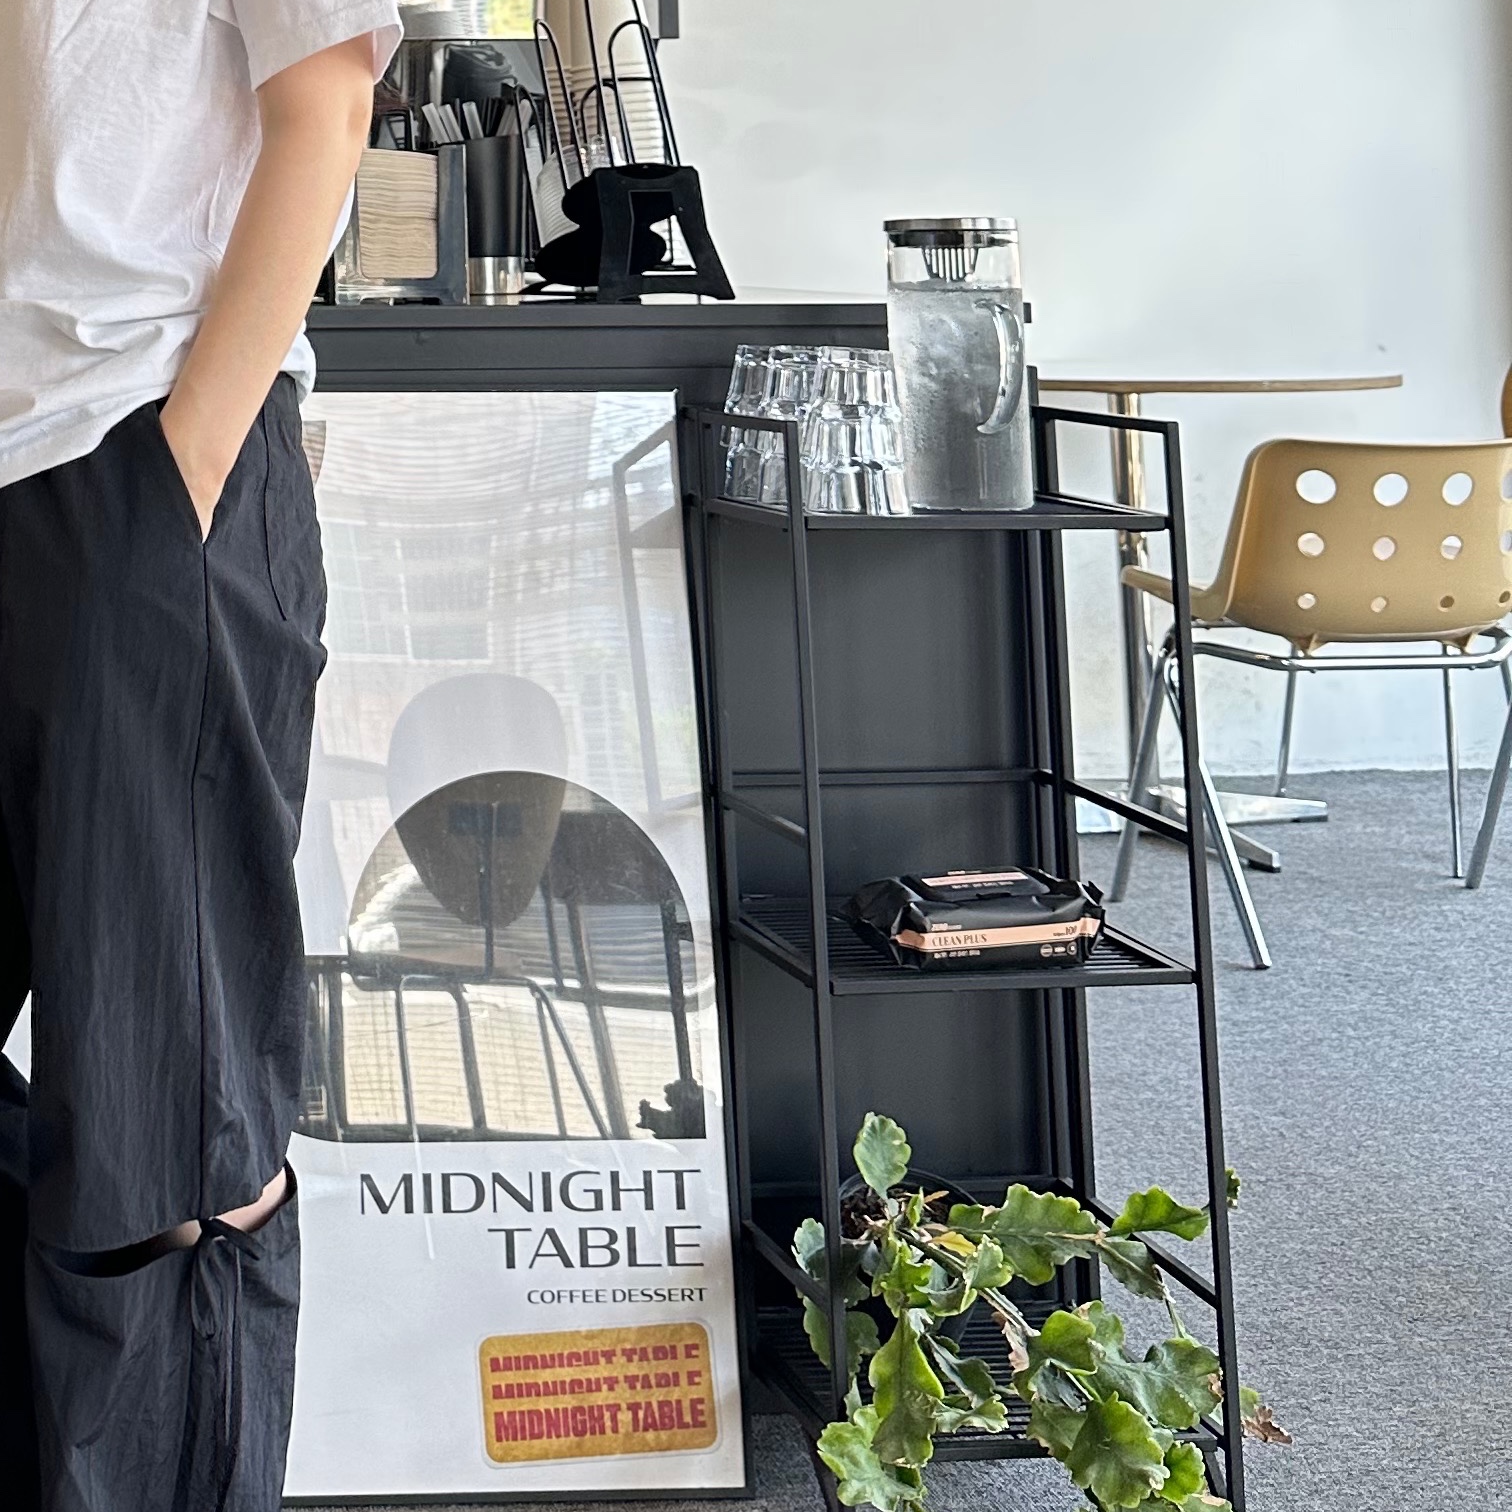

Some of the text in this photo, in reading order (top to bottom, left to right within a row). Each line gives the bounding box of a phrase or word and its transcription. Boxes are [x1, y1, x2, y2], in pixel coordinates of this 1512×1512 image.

[932, 933, 988, 947] CLEAN PLUS
[360, 1169, 702, 1215] MIDNIGHT
[487, 1225, 705, 1270] TABLE
[527, 1287, 708, 1304] COFFEE DESSERT
[494, 1397, 707, 1442] MIDNIGHT TABLE
